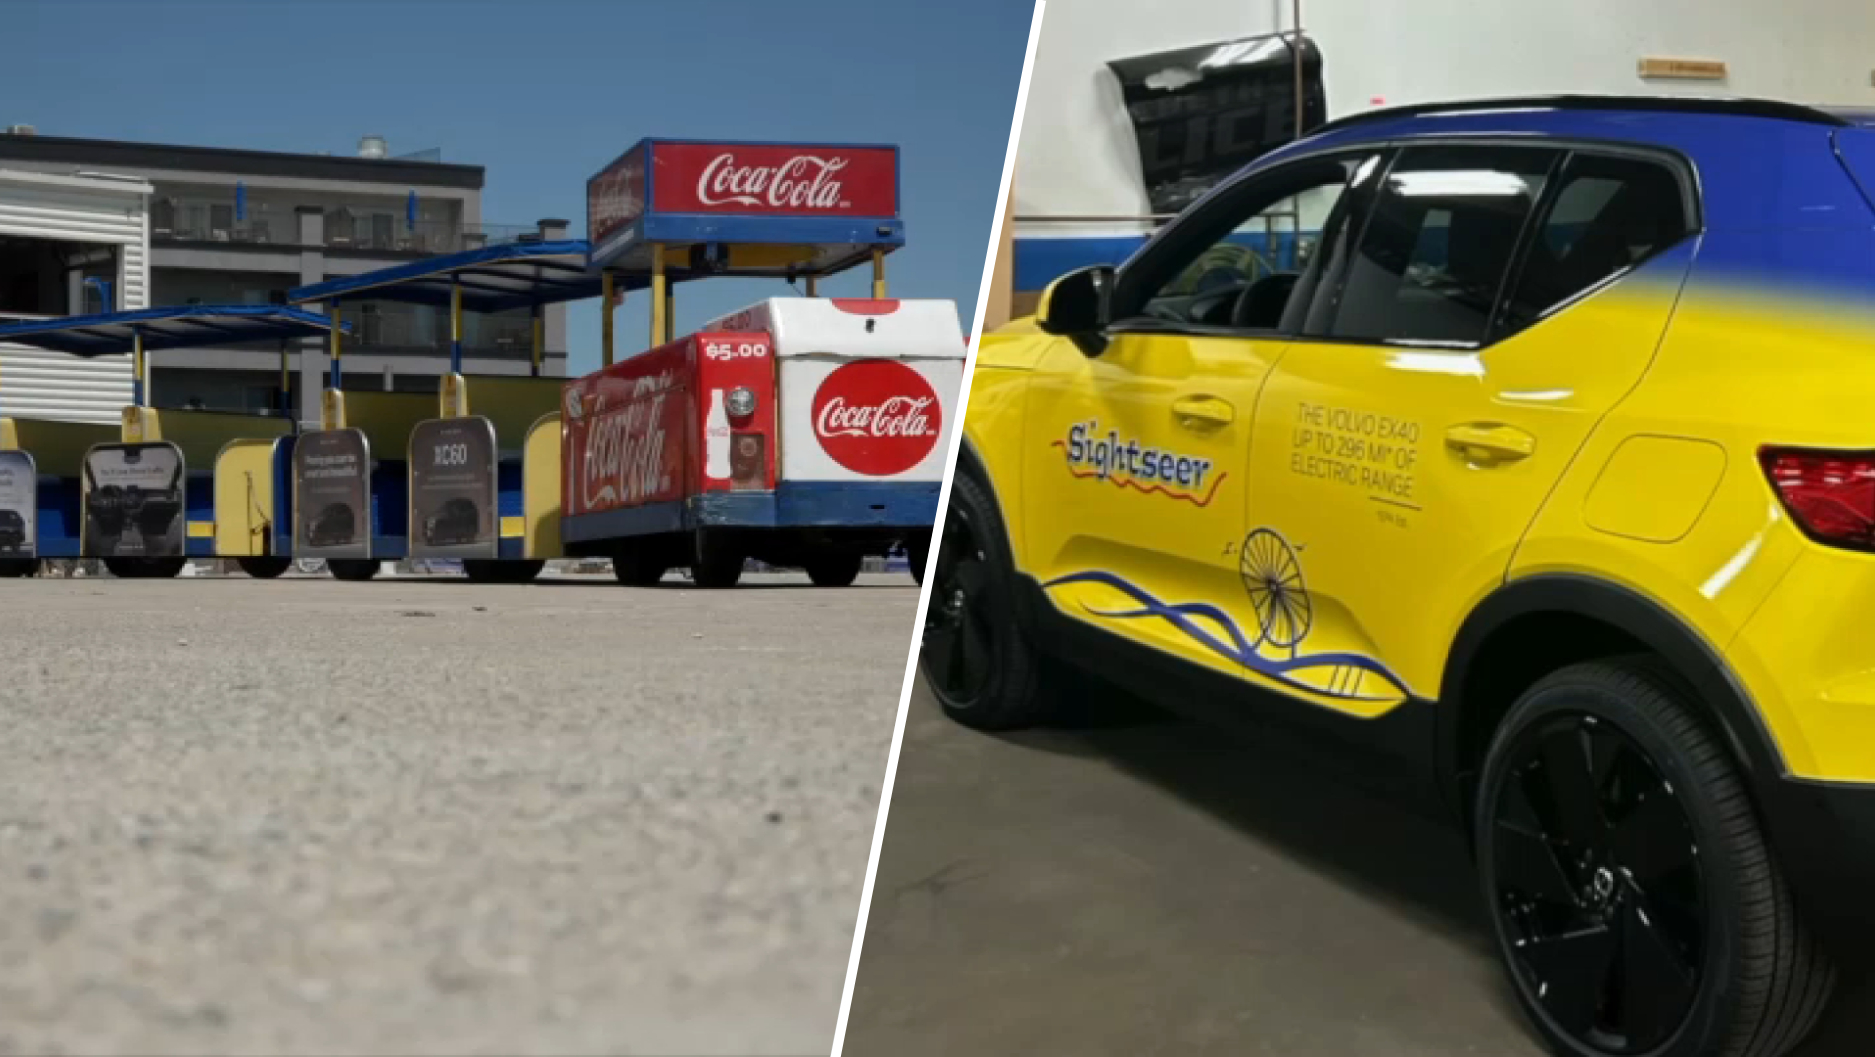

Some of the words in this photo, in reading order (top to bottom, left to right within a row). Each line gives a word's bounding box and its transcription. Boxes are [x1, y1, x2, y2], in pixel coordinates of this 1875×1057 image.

[697, 153, 850, 208] Coca-Cola
[705, 342, 767, 361] $5.00
[817, 395, 936, 438] Coca-Cola
[1299, 402, 1324, 425] THE
[1327, 407, 1376, 435] VOLVO
[1379, 416, 1419, 443] EX40
[433, 444, 467, 466] XC60
[1066, 421, 1212, 488] Sightseer
[1292, 427, 1313, 448] UP
[1317, 431, 1333, 454] TO
[1338, 435, 1365, 460] 296
[1396, 448, 1417, 469] OF
[1291, 451, 1357, 485] ELECTRIC
[1361, 466, 1414, 497] RANGE
